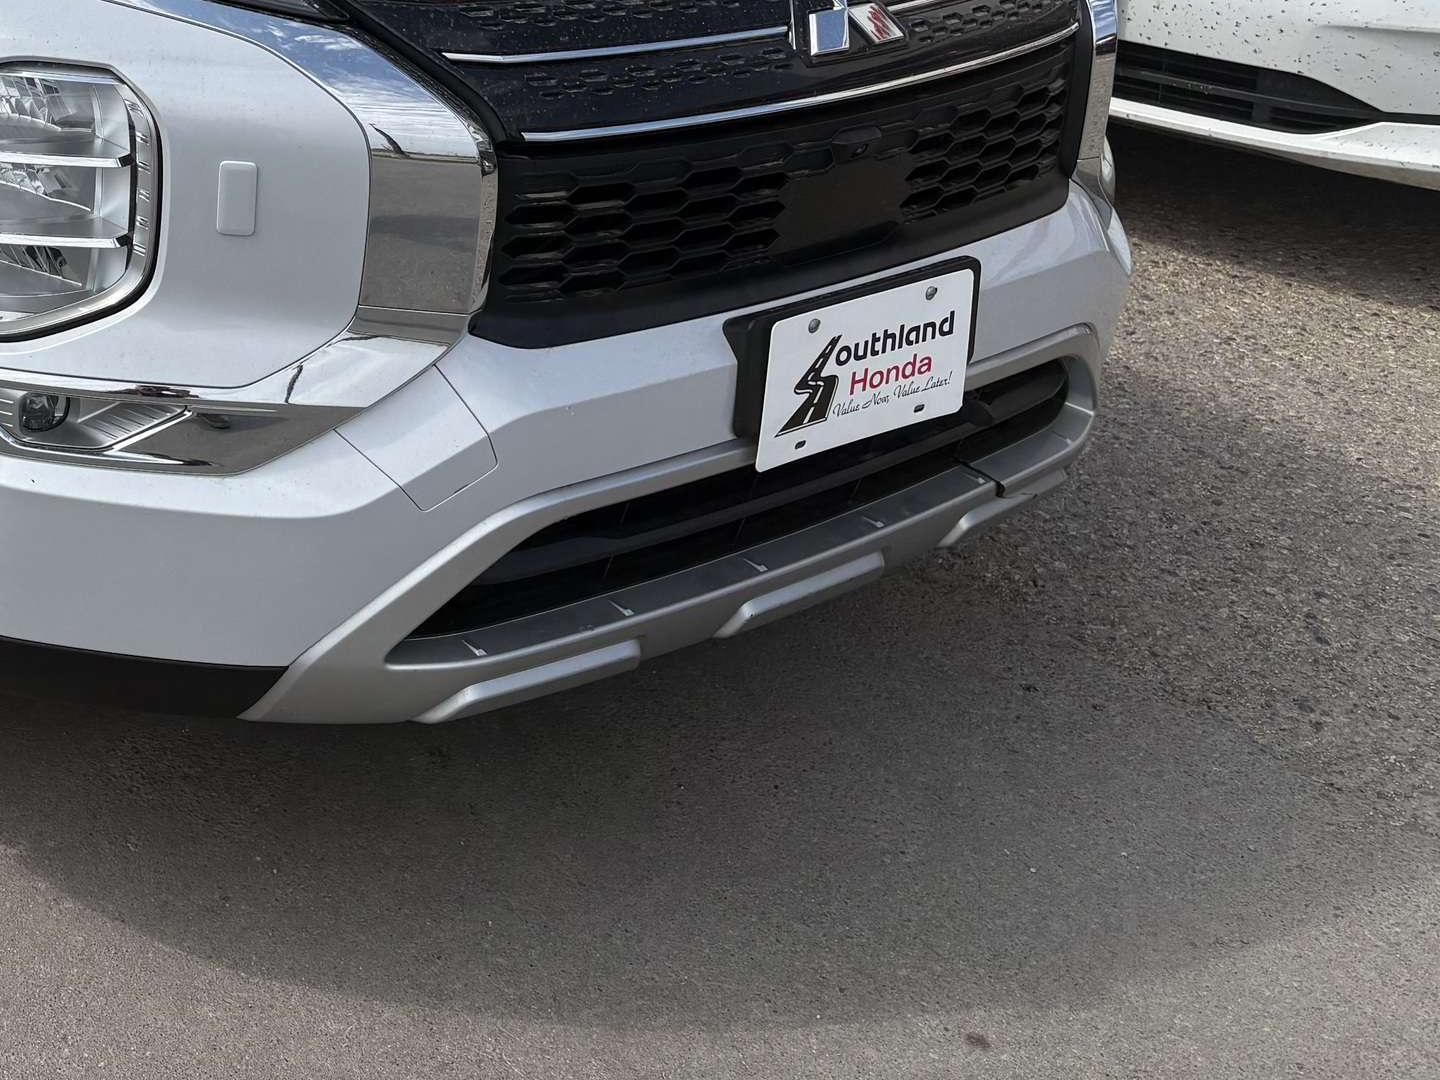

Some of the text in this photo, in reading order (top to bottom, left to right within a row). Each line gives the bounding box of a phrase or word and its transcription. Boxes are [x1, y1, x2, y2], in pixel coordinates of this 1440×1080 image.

[832, 403, 862, 418] Value
[893, 383, 922, 400] Value
[921, 371, 953, 392] Later!
[849, 353, 934, 396] Honda
